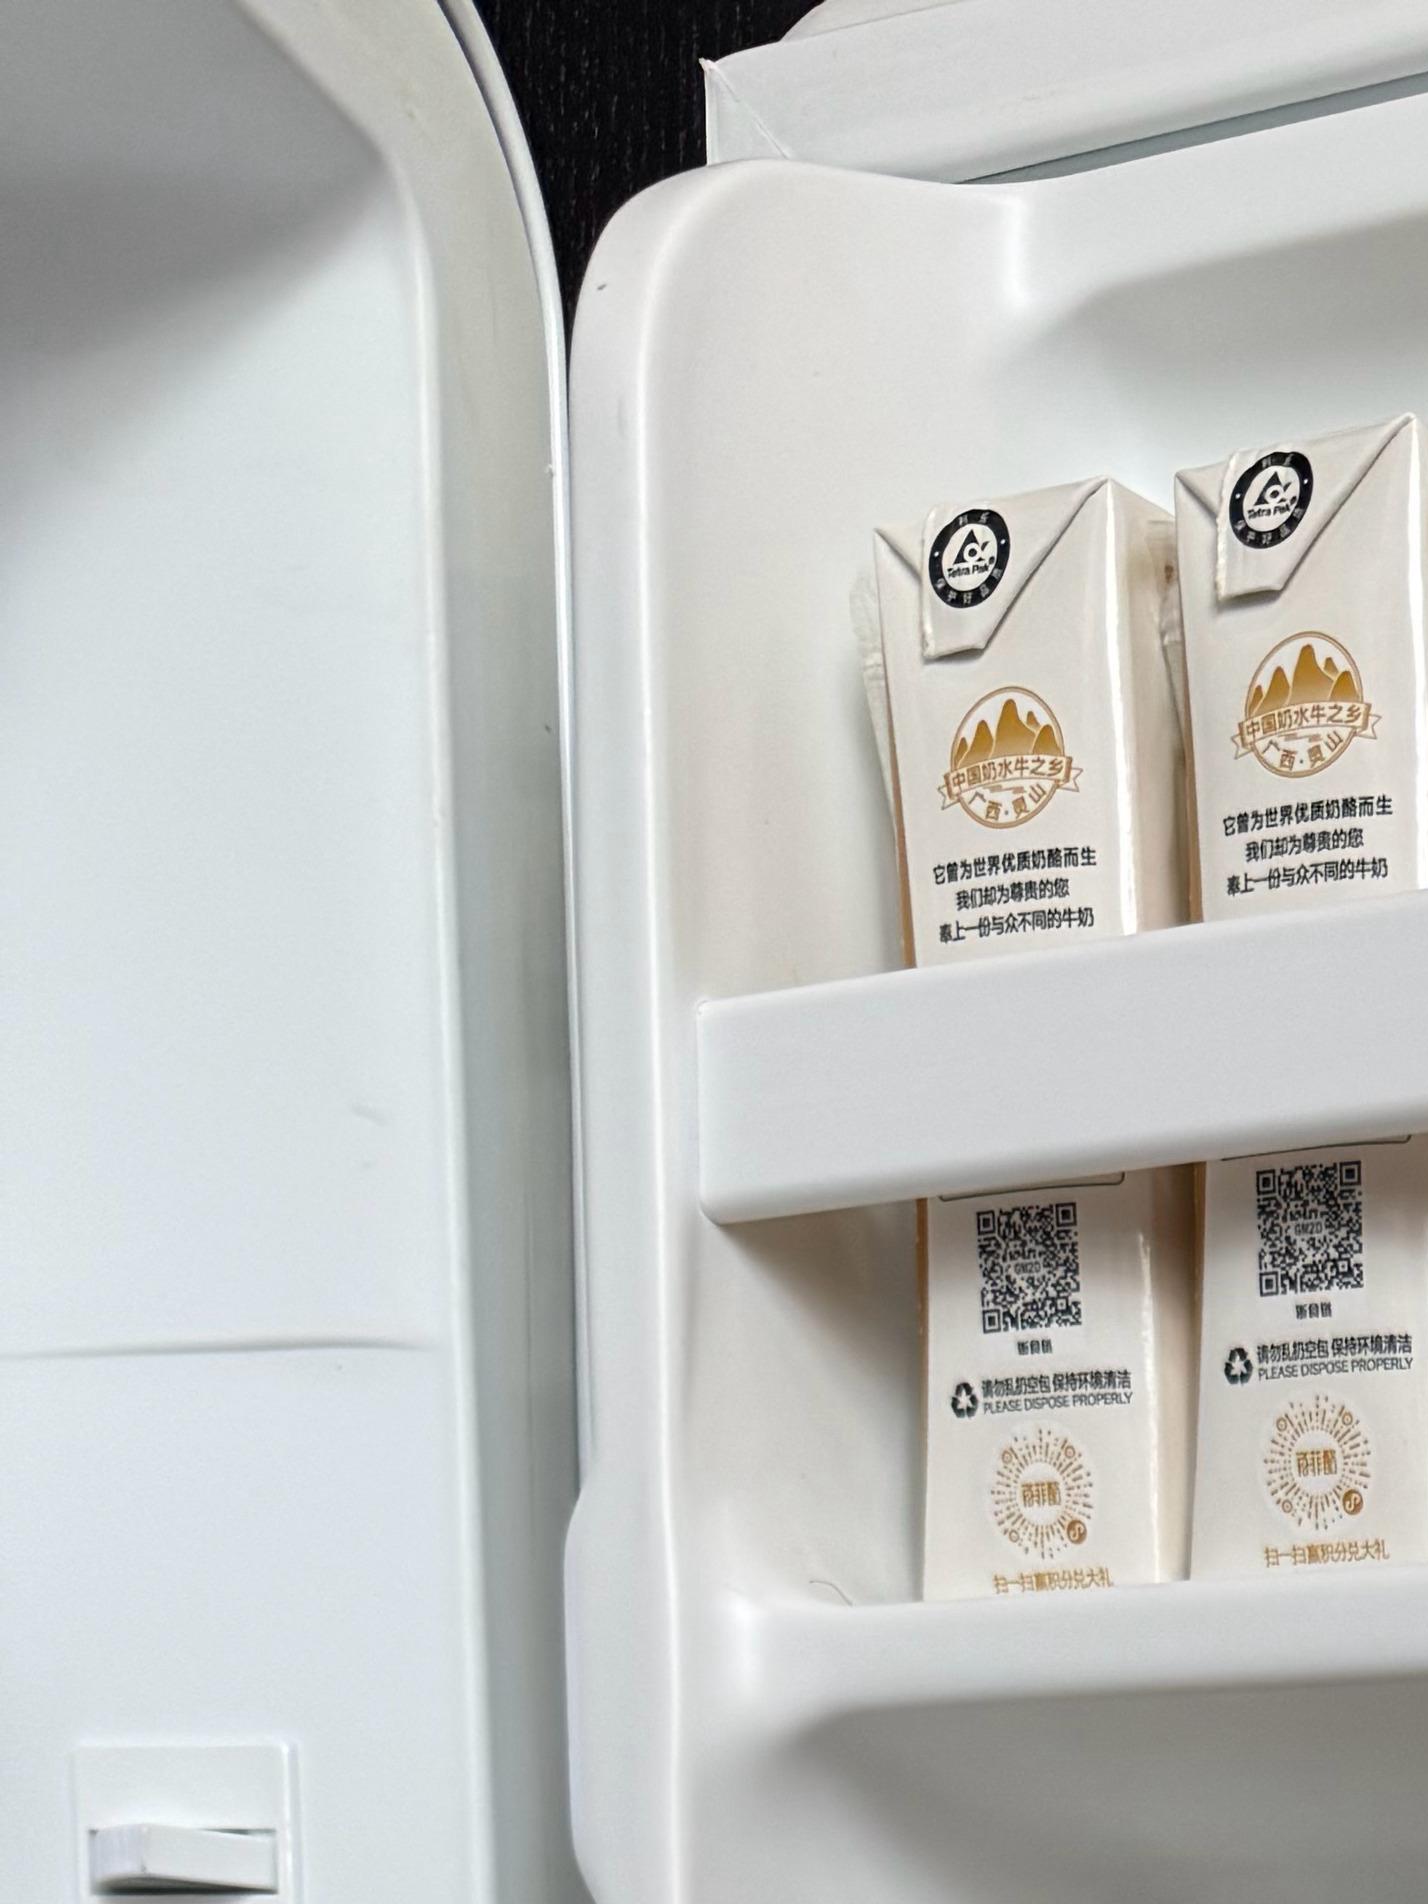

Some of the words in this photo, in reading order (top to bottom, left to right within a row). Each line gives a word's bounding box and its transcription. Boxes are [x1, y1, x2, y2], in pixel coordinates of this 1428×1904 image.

[1245, 705, 1362, 738] 中国奶水牛之乡
[952, 757, 1064, 793] 中国奶水牛之乡
[1223, 795, 1393, 837] 它曾为世界优质奶酪而生
[1246, 828, 1364, 863] 我们却为尊贵的您
[933, 846, 1097, 885] 它曾为世界优质奶酪而生
[956, 878, 1070, 911] 我们却为尊贵的您
[1258, 1367, 1298, 1381] PLEASE
[1301, 1362, 1348, 1376] DISPOSE
[1352, 1357, 1413, 1372] PROPERLY
[984, 1399, 1024, 1415] PLEASE
[1025, 1396, 1070, 1411] DISPOSE
[1073, 1392, 1133, 1407] PROPERLY
